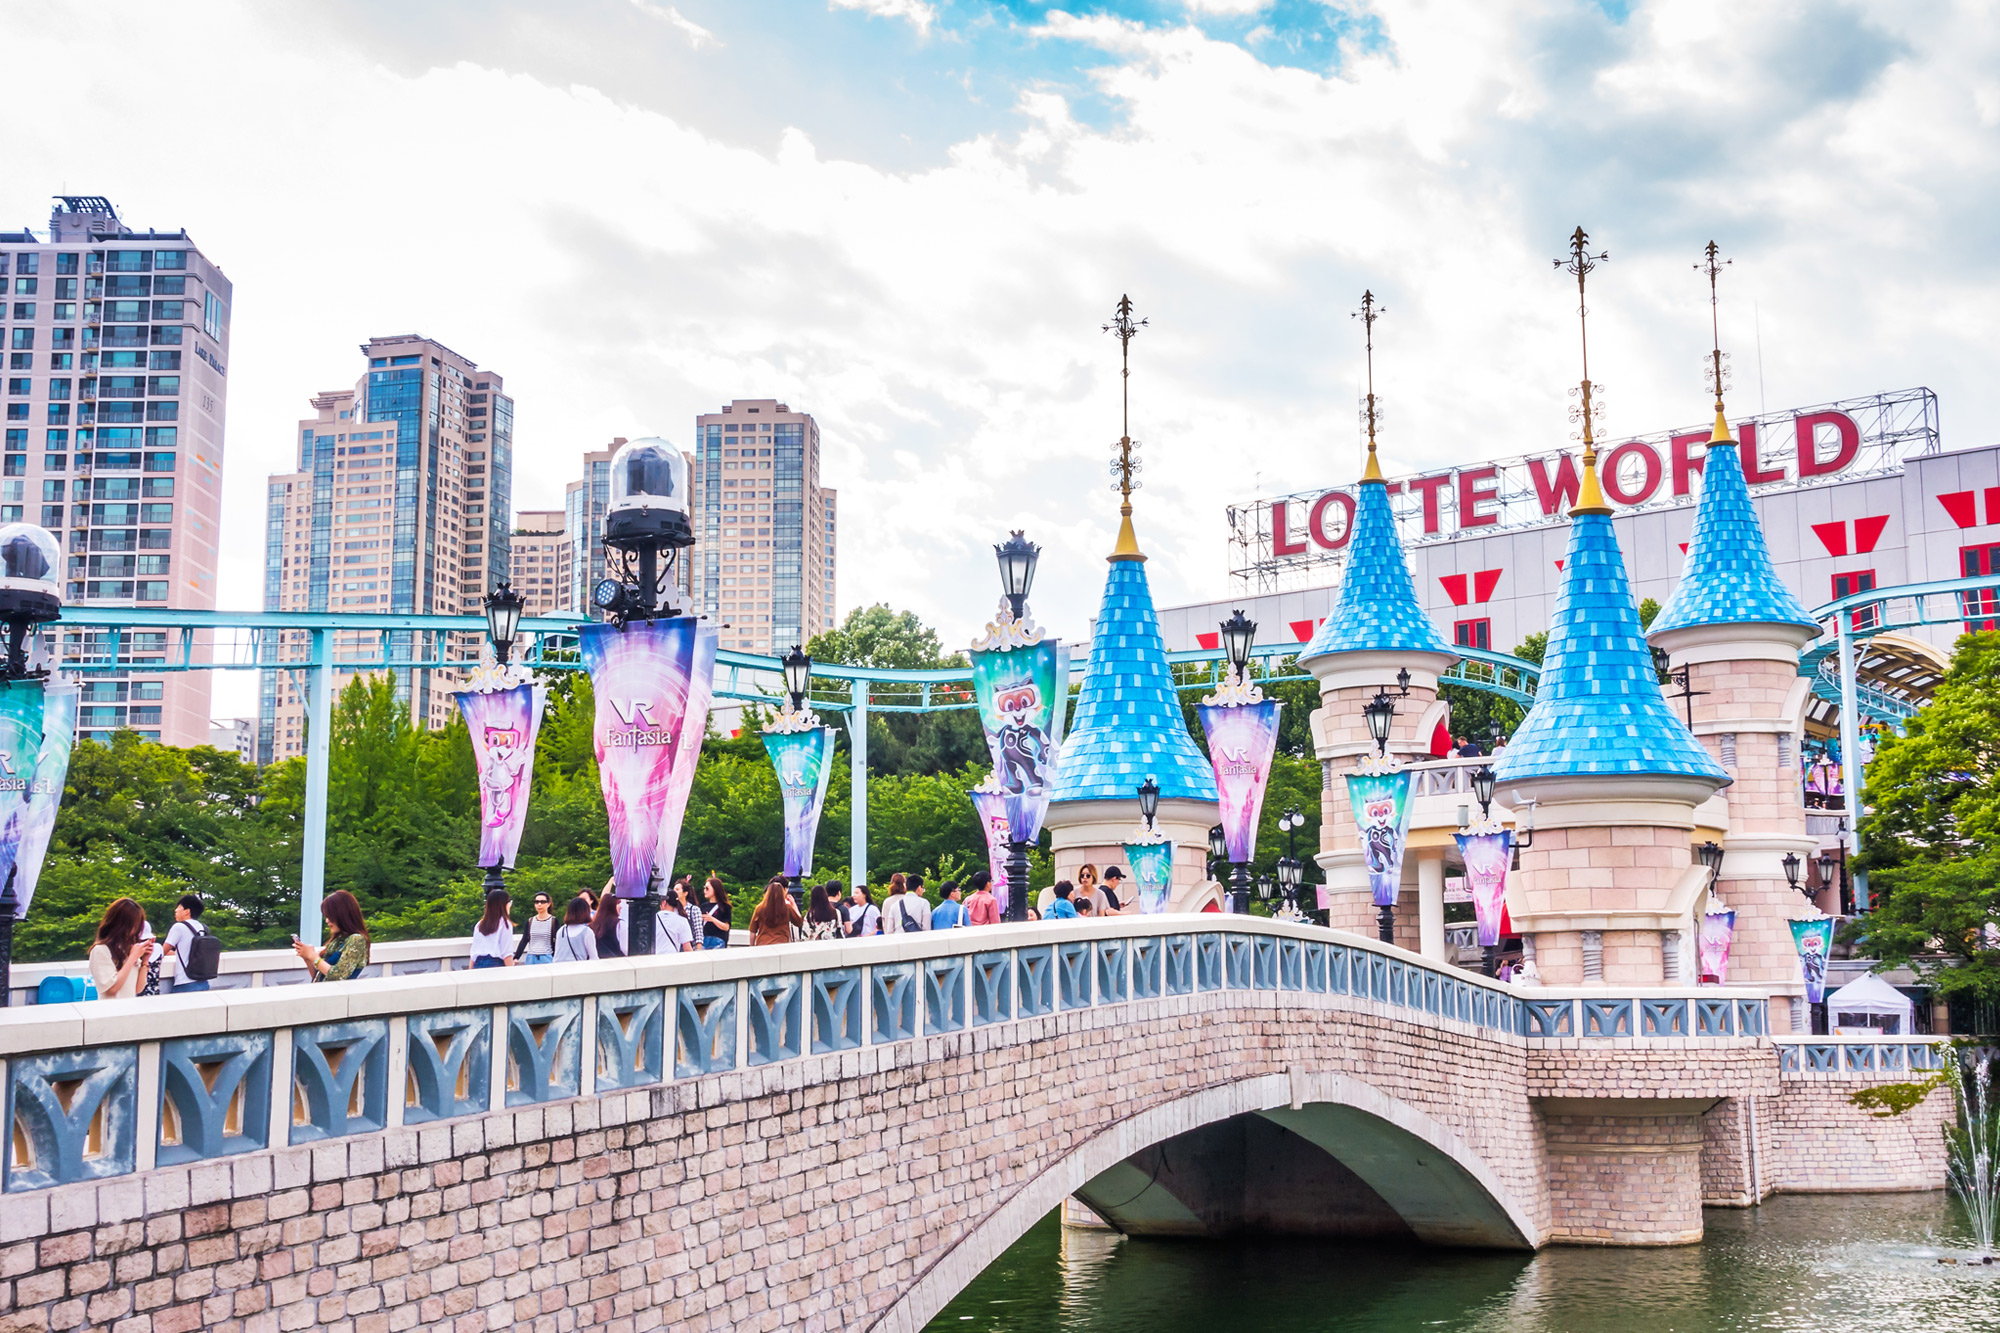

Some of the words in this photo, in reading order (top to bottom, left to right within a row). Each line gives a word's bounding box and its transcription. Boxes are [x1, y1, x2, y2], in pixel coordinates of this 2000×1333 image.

[608, 697, 660, 726] VR
[602, 725, 672, 753] Fantasia
[1220, 746, 1251, 763] VR
[782, 770, 806, 786] VR
[783, 785, 812, 799] antasia
[1141, 871, 1160, 883] VR
[1472, 863, 1497, 876] VR
